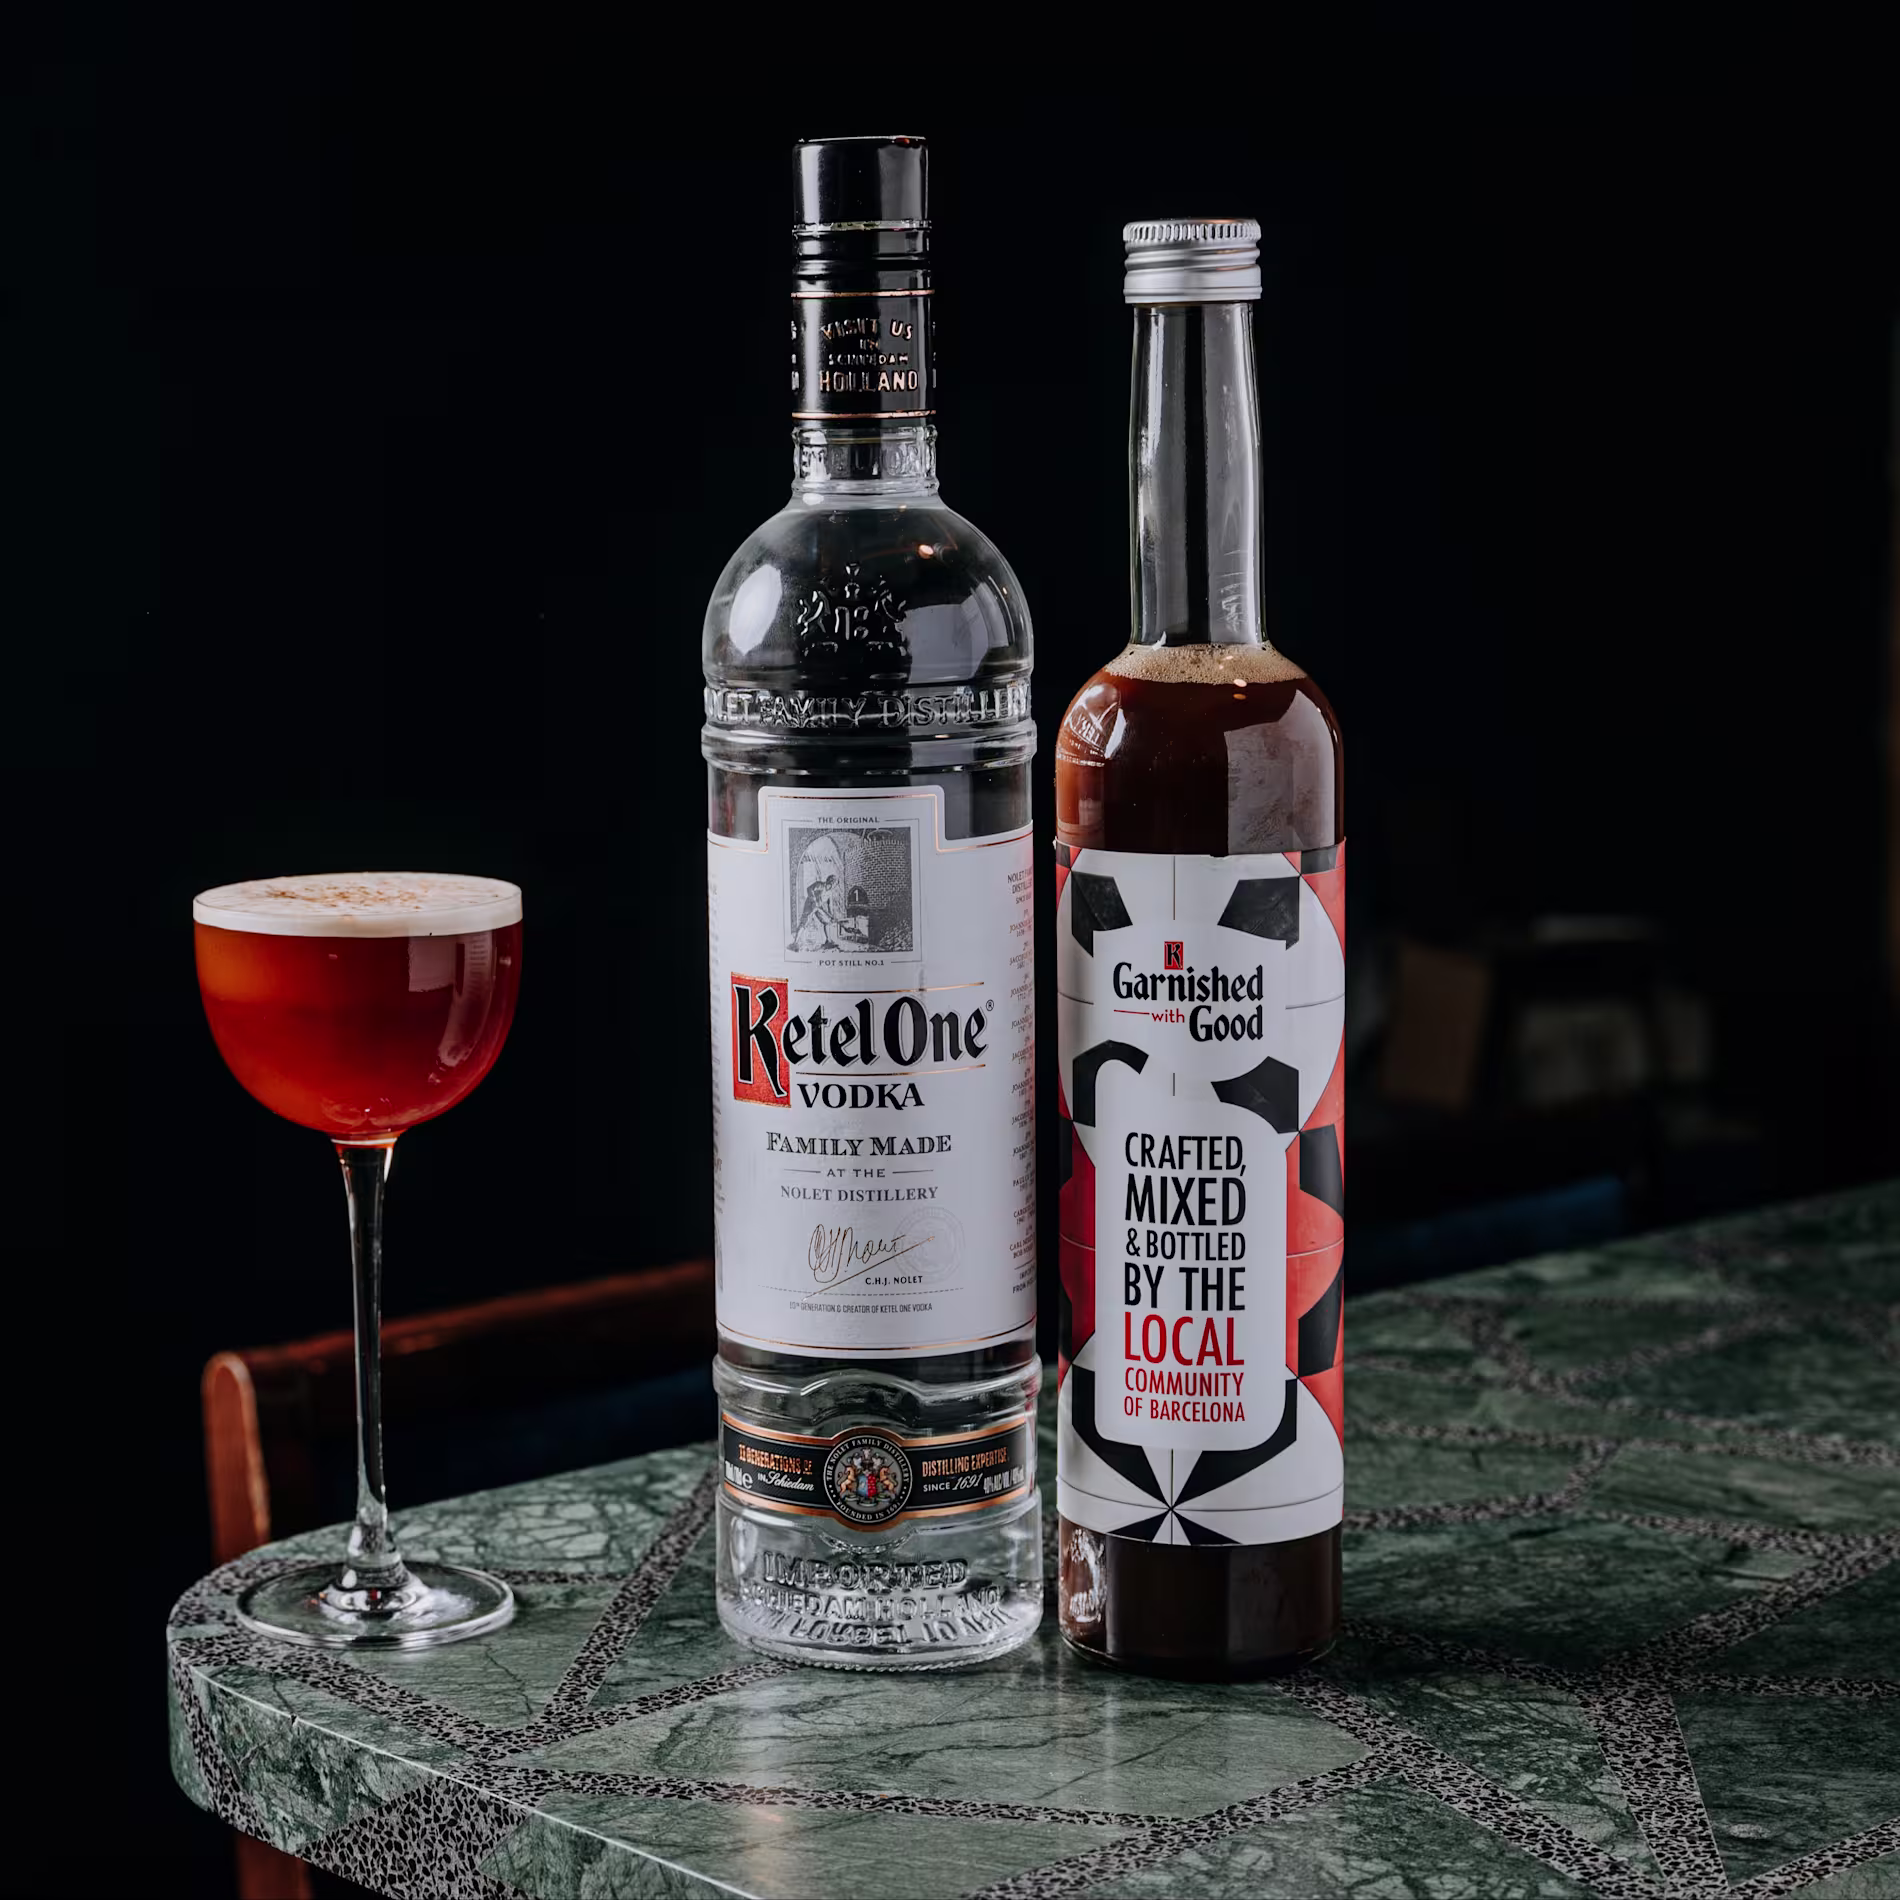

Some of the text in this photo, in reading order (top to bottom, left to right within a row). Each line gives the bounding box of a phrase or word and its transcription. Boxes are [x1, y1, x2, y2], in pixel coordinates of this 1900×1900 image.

[891, 320, 913, 340] US
[819, 370, 919, 392] HOLLAND
[817, 815, 880, 824] THE ORIGINAL
[838, 959, 863, 967] STILL
[1165, 942, 1184, 969] K
[1112, 962, 1264, 1002] Garnished
[1151, 1004, 1264, 1042] with Good
[732, 984, 877, 1097] Ketel
[797, 1082, 925, 1110] VODKA
[766, 1131, 952, 1157] FAMILY MADE
[1125, 1132, 1247, 1177] CRAFTED,
[826, 1168, 886, 1178] AT THE
[780, 1185, 939, 1202] NOLET DISTILLERY
[1125, 1173, 1247, 1226] MIXED
[1125, 1227, 1246, 1261] & BOTTLED
[865, 1275, 924, 1287] C.H.J. NOLET
[1124, 1262, 1246, 1311] BY THE
[800, 1302, 836, 1313] GENERATION
[842, 1304, 870, 1314] CREATOR
[871, 1305, 879, 1313] OF
[880, 1304, 899, 1313] KETEL
[899, 1303, 911, 1313] ONE
[912, 1302, 933, 1313] VODKA
[1124, 1311, 1245, 1366] LOCAL
[1124, 1367, 1245, 1397] COMMUNITY
[1124, 1395, 1246, 1422] OF BARCELONA
[746, 1446, 801, 1475] GENERATIONS
[826, 1438, 910, 1483] THE NOLET FAMILY DISTILLERY
[921, 1455, 970, 1477] DISTILLING
[757, 1473, 766, 1482] IN
[766, 1470, 815, 1491] Schiedam
[923, 1472, 984, 1492] SINCE 1691
[836, 1499, 901, 1520] FOUNDED IN 1691
